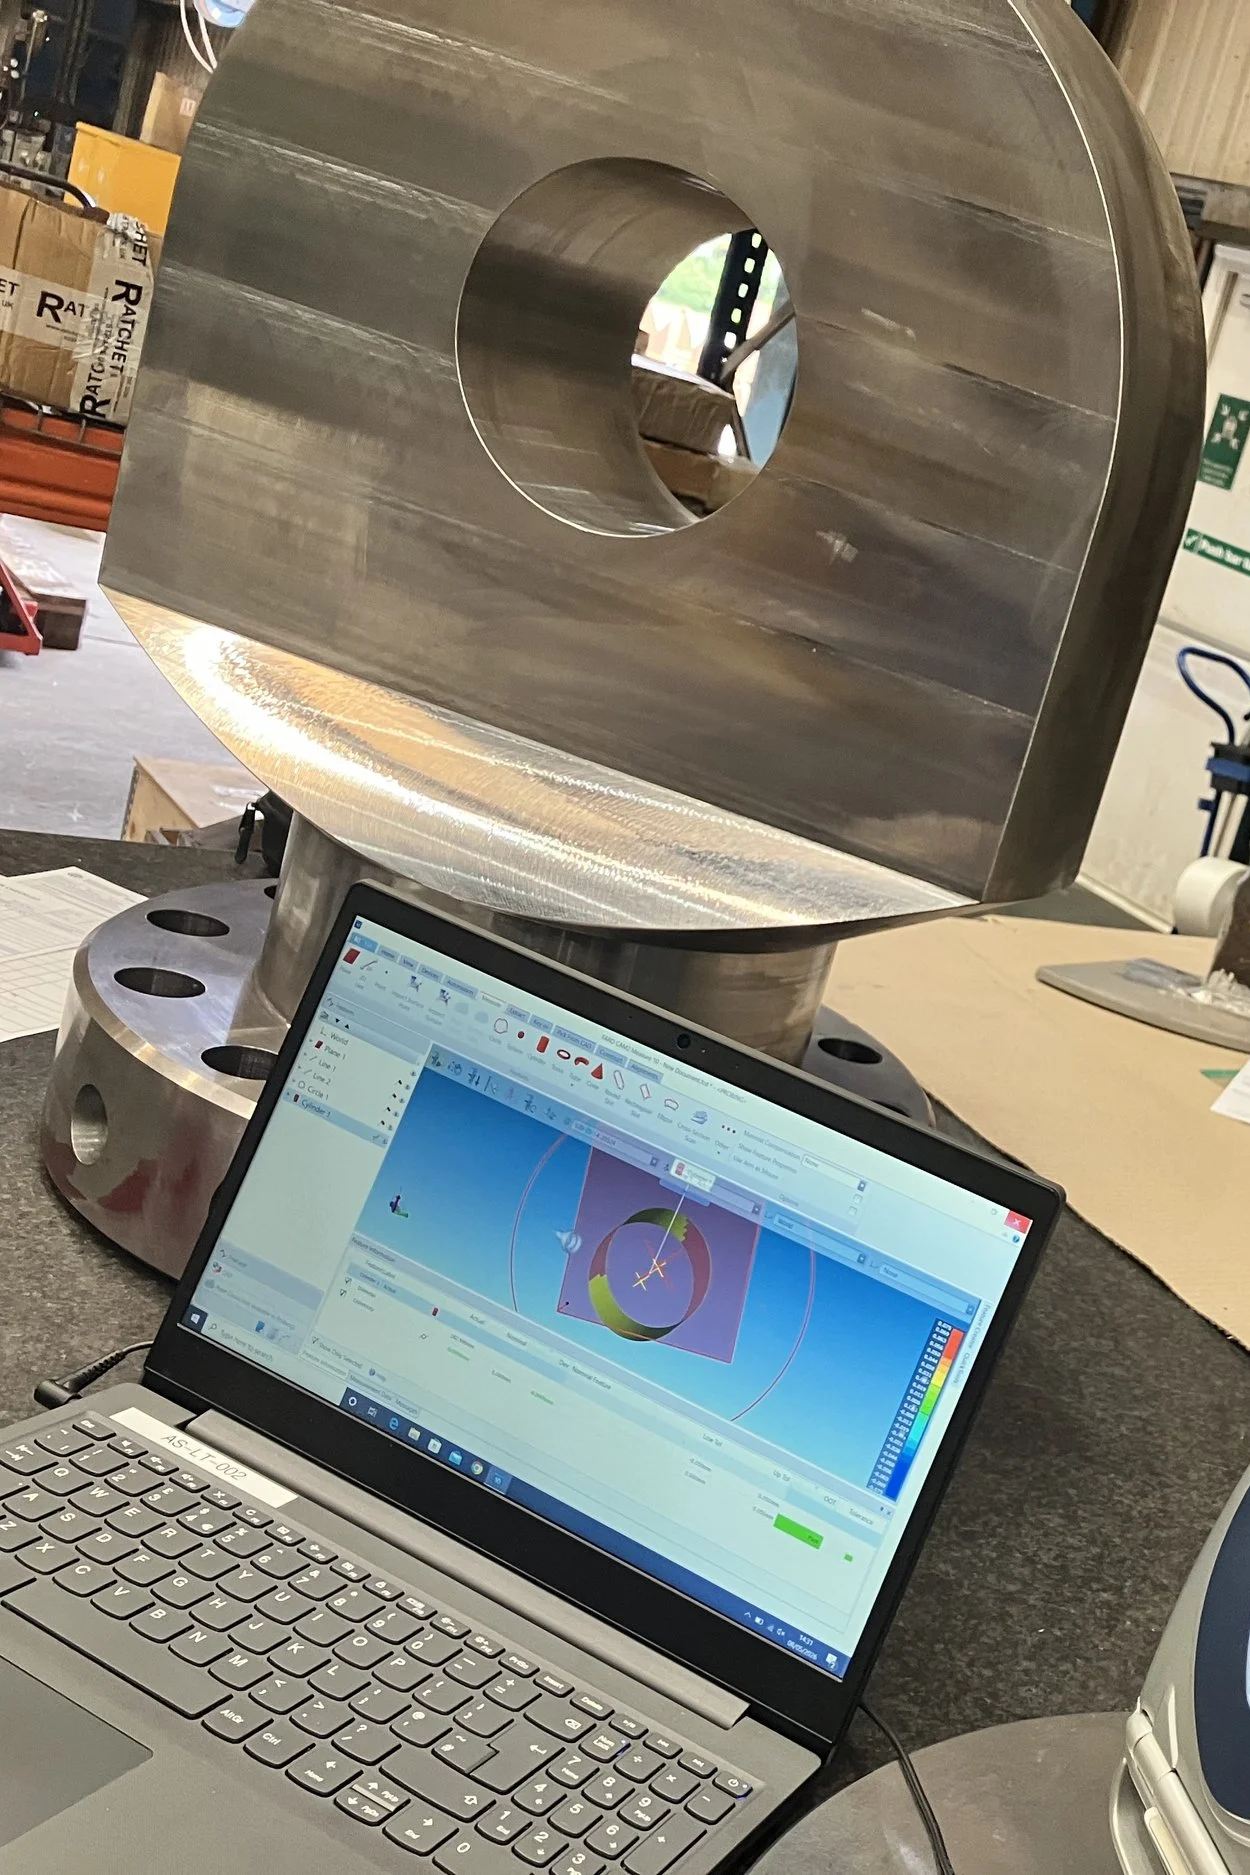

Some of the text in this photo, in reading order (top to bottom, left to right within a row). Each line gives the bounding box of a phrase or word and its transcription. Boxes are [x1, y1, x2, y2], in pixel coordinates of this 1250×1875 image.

[110, 279, 144, 375] RATCHET
[329, 1031, 349, 1046] World
[323, 1044, 346, 1060] Plane 1
[317, 1058, 336, 1073] Line 1
[312, 1071, 331, 1086] Line 2
[306, 1084, 329, 1100] Circle 1
[300, 1098, 328, 1118] Cylinder
[219, 1328, 274, 1363] Type here to search
[161, 1433, 248, 1481] AS-LT-002
[54, 1468, 69, 1476] Q
[112, 1474, 126, 1482] 2
[22, 1492, 39, 1501] A
[90, 1488, 109, 1498] W
[60, 1513, 75, 1521] S
[124, 1508, 141, 1517] E
[0, 1521, 17, 1531] Z
[160, 1528, 178, 1537] R
[96, 1534, 112, 1542] D
[36, 1543, 55, 1553] X
[133, 1554, 150, 1563] F
[200, 1550, 215, 1558] T
[75, 1566, 91, 1574] C
[238, 1570, 253, 1579] Y
[172, 1577, 188, 1586] G
[114, 1587, 130, 1596] V
[274, 1592, 291, 1601] U
[209, 1598, 227, 1608] H
[334, 1598, 346, 1606] 8
[150, 1609, 166, 1618] B
[311, 1613, 324, 1621] I
[249, 1622, 264, 1630] J
[188, 1632, 205, 1643] N
[353, 1637, 368, 1646] O
[287, 1643, 305, 1654] K
[411, 1641, 423, 1649] 0
[228, 1655, 248, 1666] M
[390, 1658, 406, 1666] P
[328, 1666, 339, 1675] L
[543, 1676, 564, 1689] Insert
[220, 1709, 244, 1724] AltGr
[263, 1732, 281, 1745] Ctrl
[568, 1756, 581, 1765] 7
[305, 1770, 324, 1782] Home
[602, 1777, 616, 1786] 8
[534, 1783, 547, 1792] 4
[638, 1798, 651, 1807] 9
[569, 1804, 583, 1813] 5
[500, 1811, 511, 1820] 1
[606, 1825, 619, 1835] 6
[534, 1832, 549, 1842] 2
[456, 1843, 471, 1853] 0
[572, 1853, 585, 1864] 3
